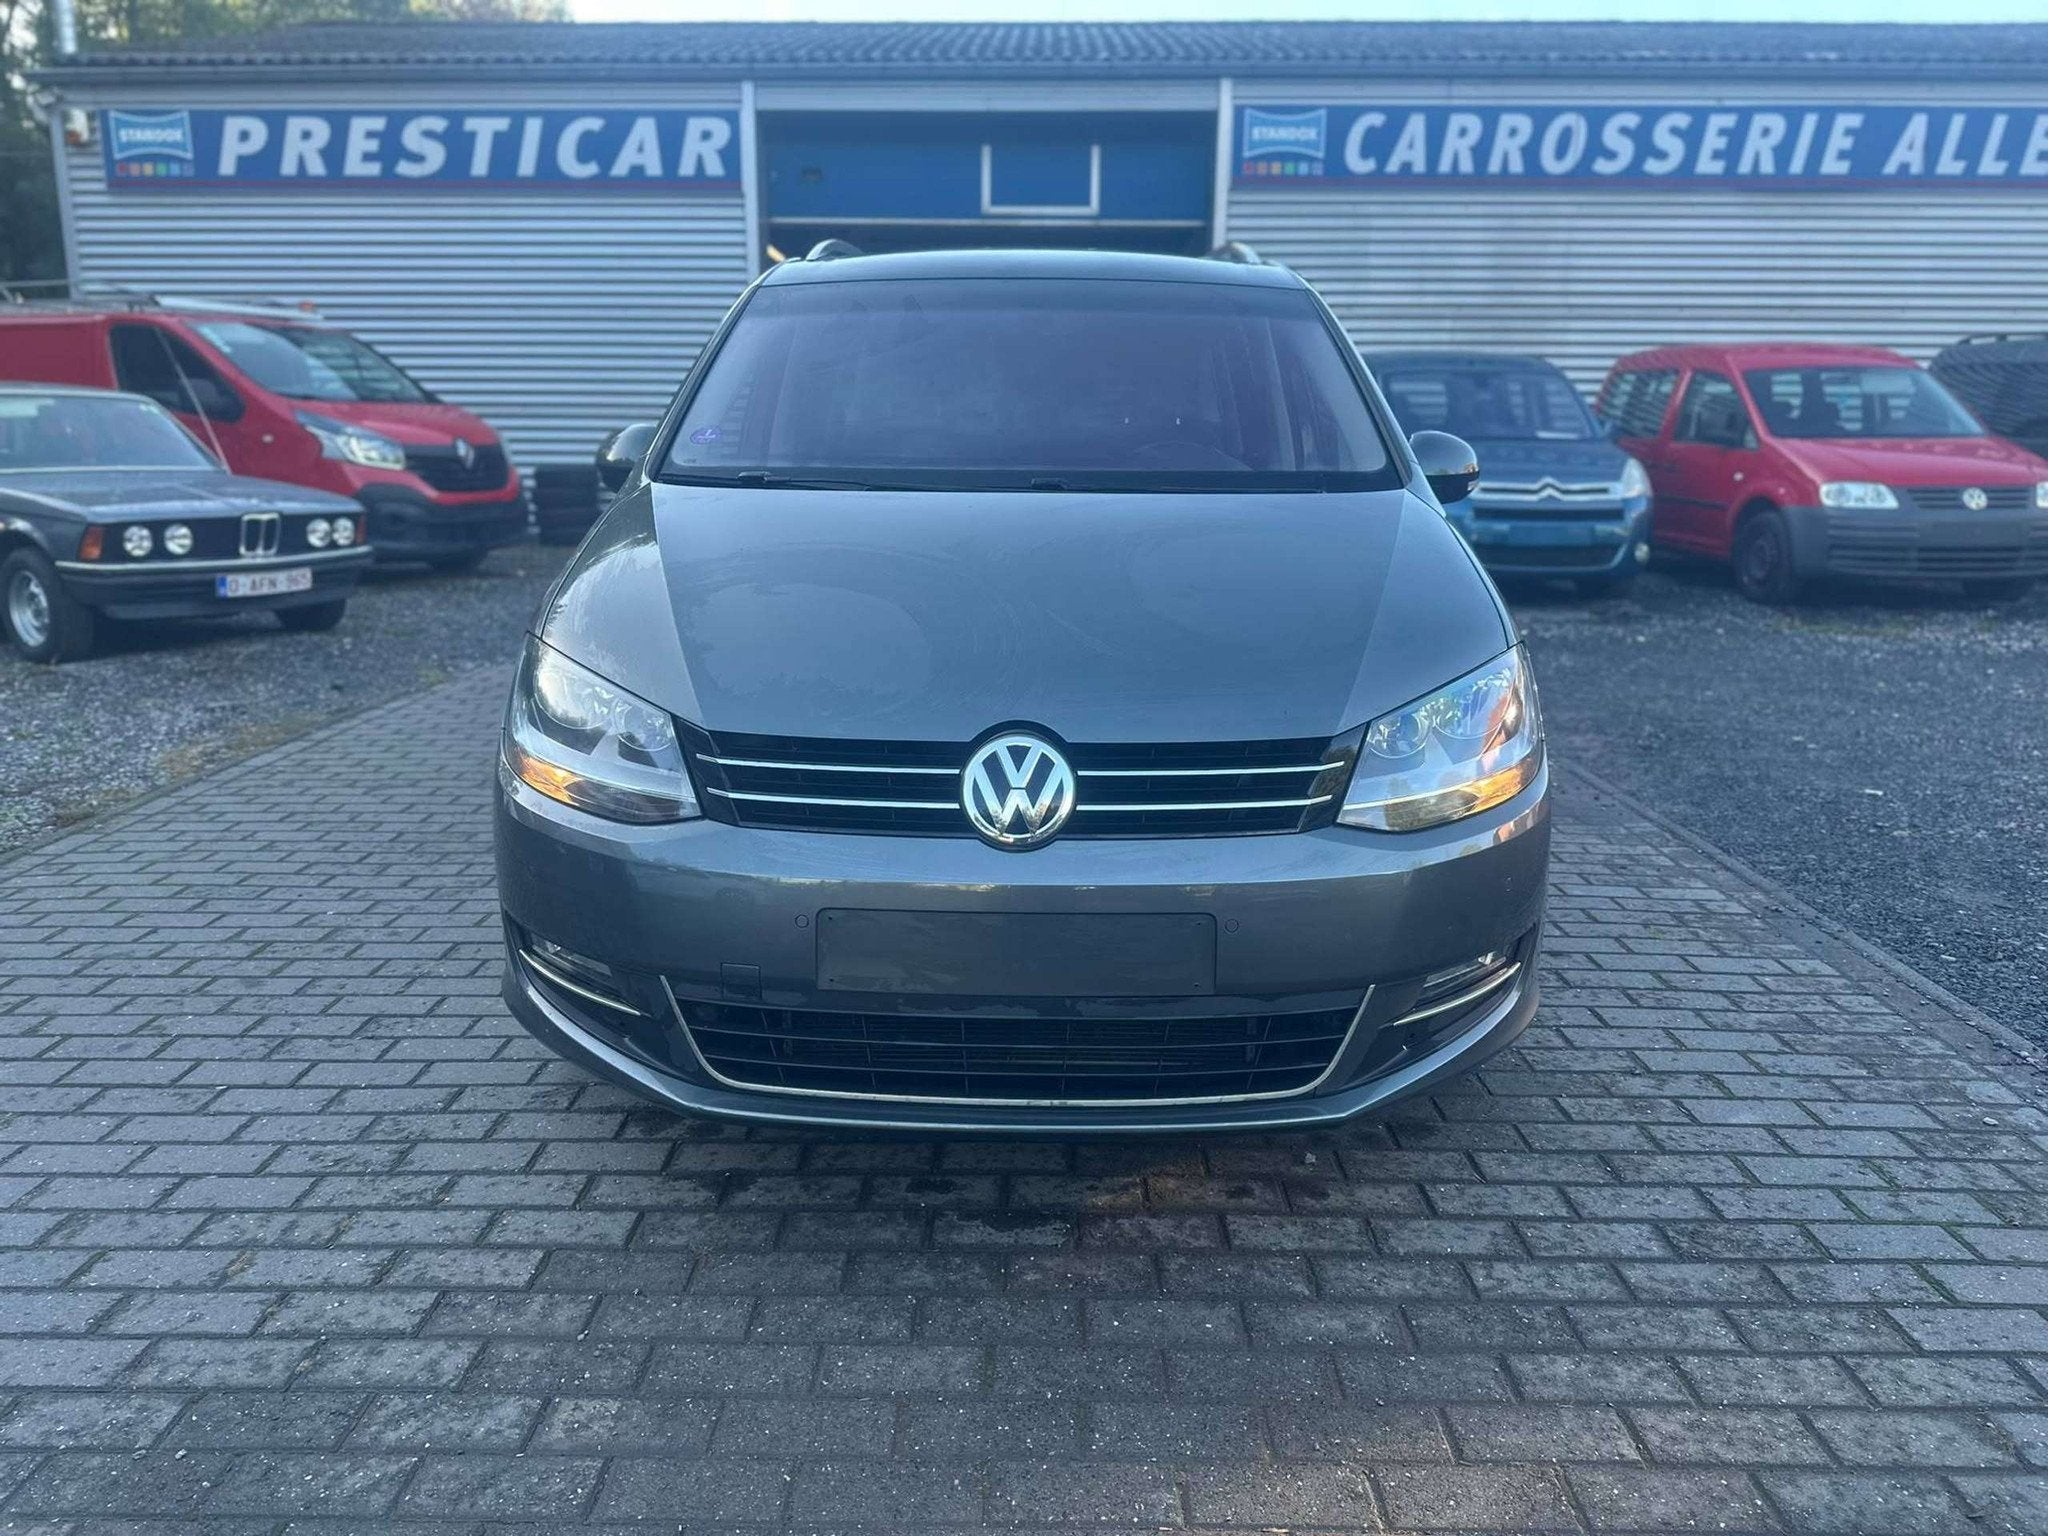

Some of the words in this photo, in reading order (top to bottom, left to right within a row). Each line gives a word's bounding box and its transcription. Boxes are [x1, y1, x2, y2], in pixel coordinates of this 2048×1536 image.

[218, 115, 732, 178] PRESTICAR
[1343, 111, 1866, 175] CARROSSERIE
[1880, 112, 2048, 175] ALLE
